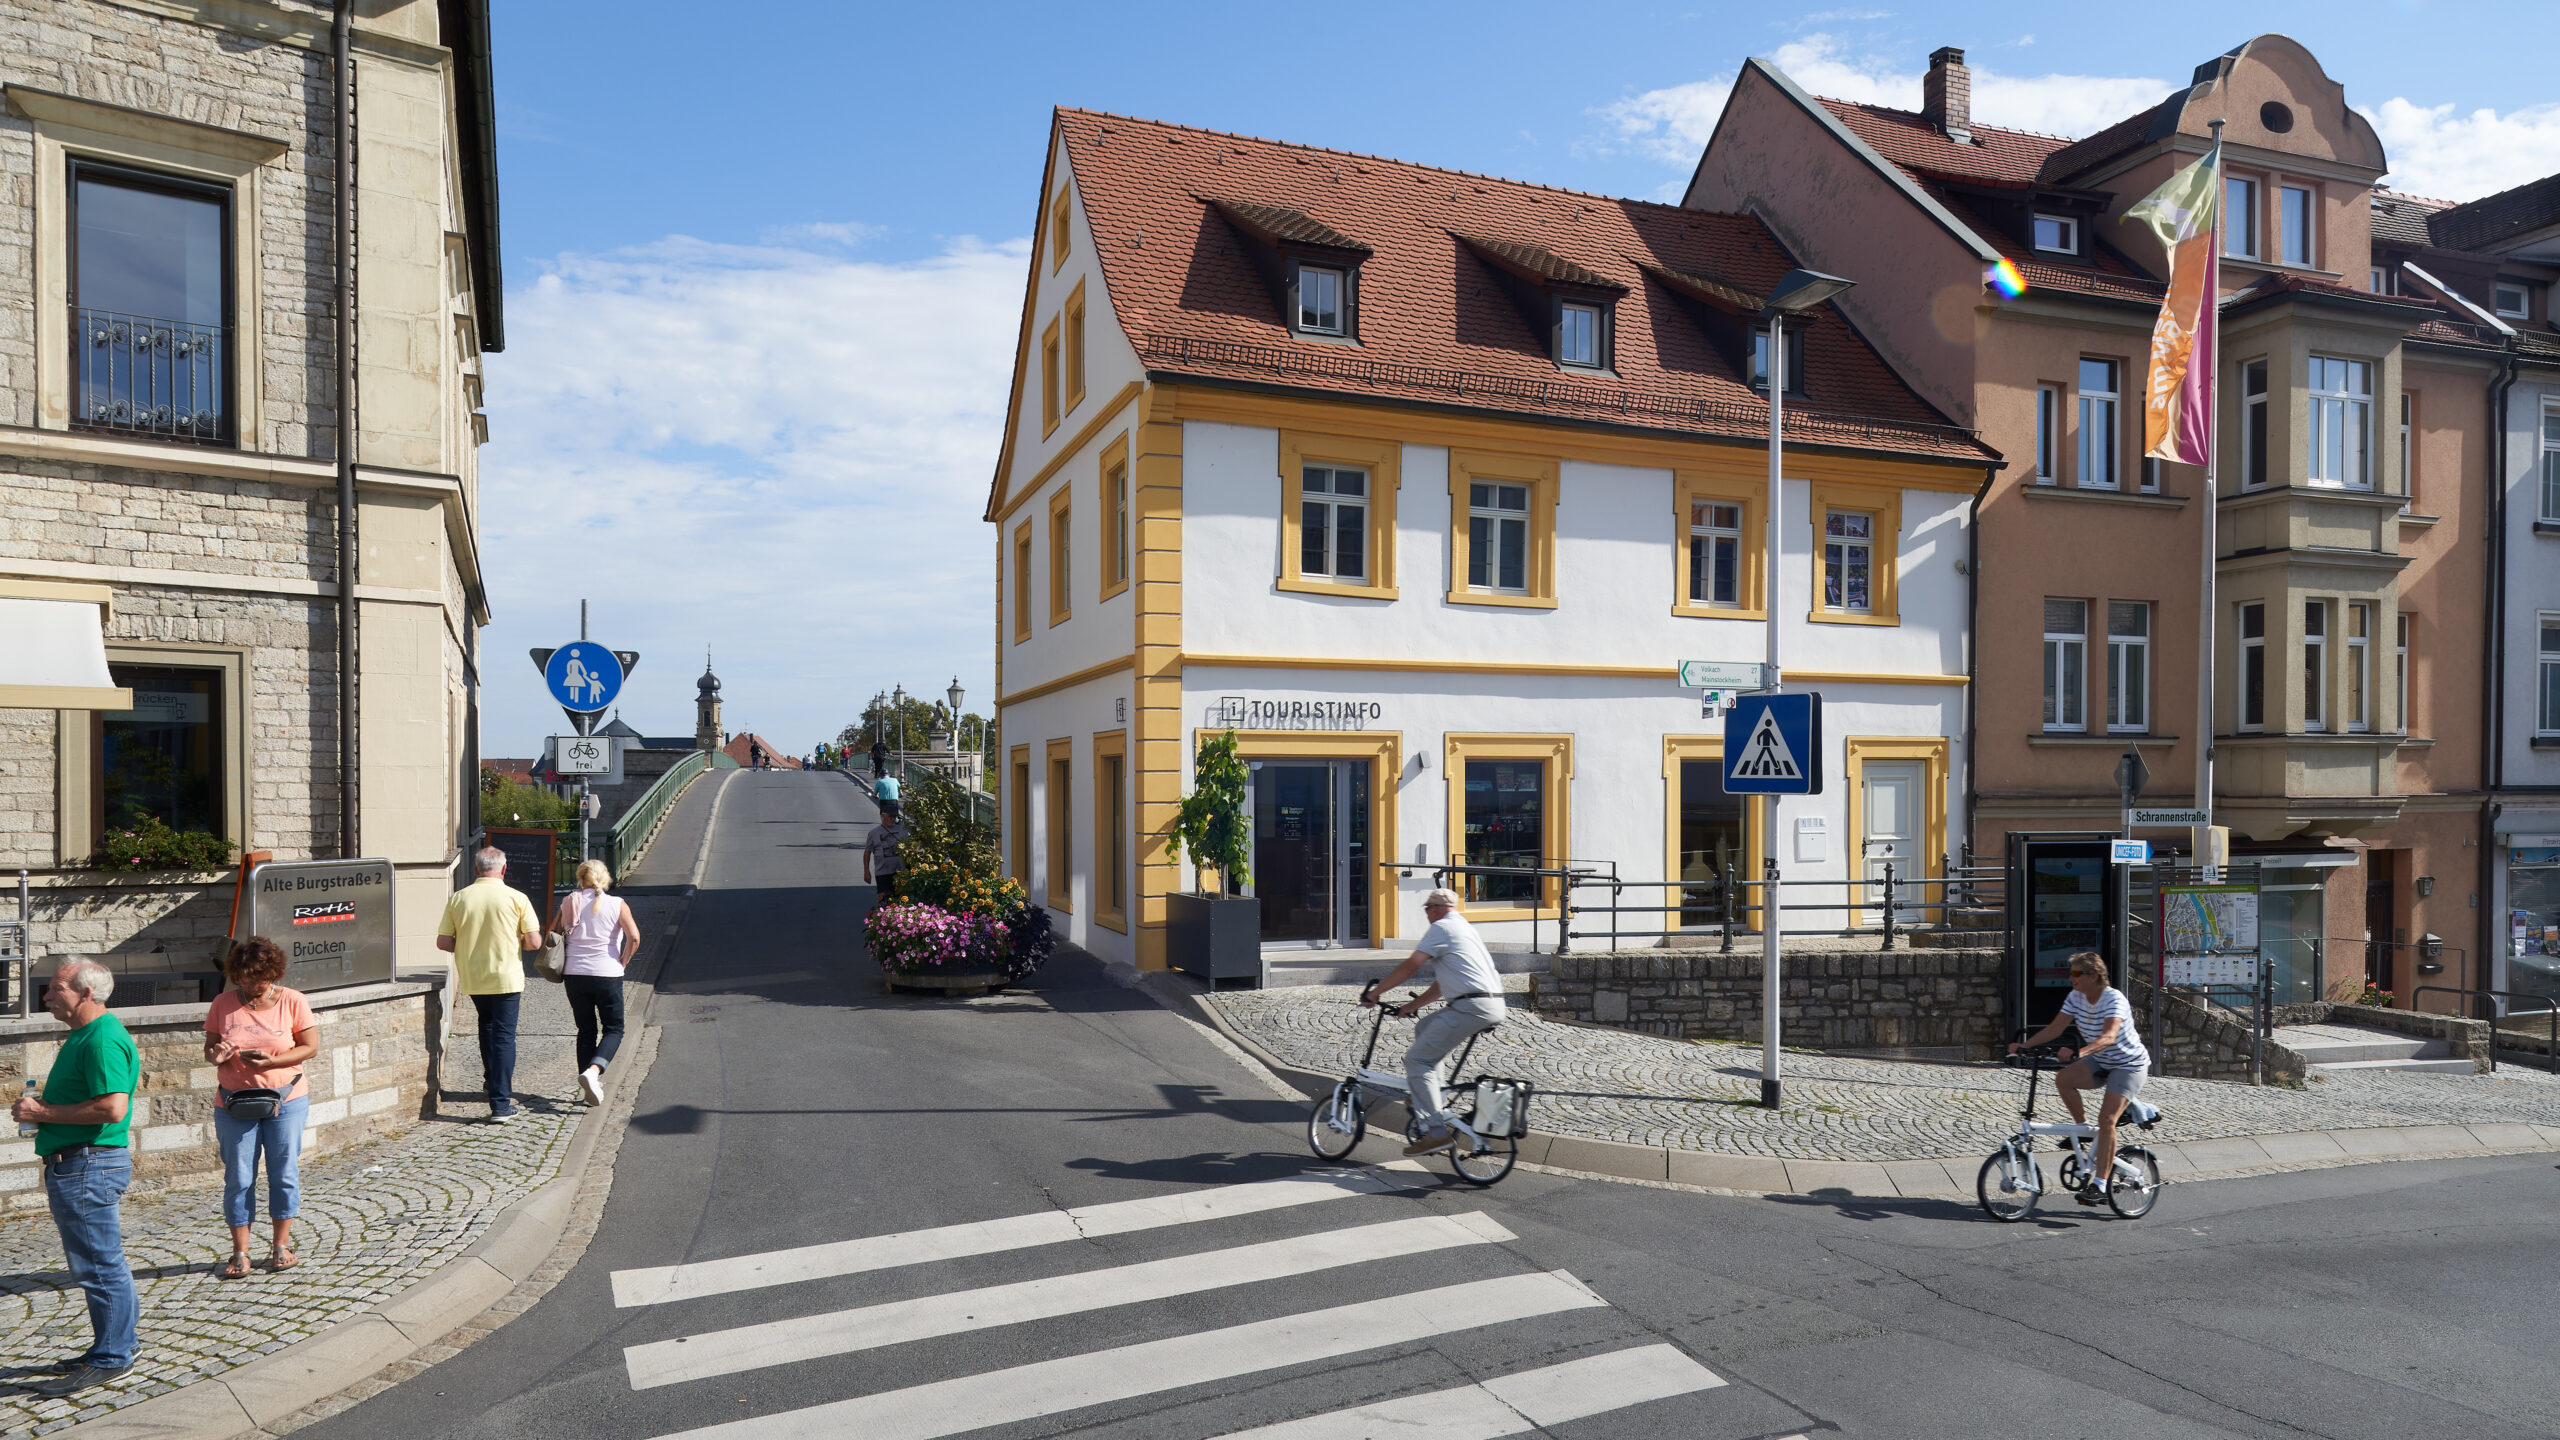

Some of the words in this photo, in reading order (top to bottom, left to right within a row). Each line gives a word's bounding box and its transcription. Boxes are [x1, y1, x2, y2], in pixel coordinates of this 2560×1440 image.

[1751, 667, 1758, 675] 27
[1252, 700, 1381, 720] TOURISTINFO
[575, 760, 594, 770] frei
[2136, 811, 2207, 823] Schrannenstraße
[263, 877, 293, 893] Alte
[296, 873, 372, 892] Burgstraße
[374, 872, 382, 885] 2
[294, 902, 355, 917] Roth
[293, 914, 355, 925] PARTNER
[293, 940, 346, 958] Brücken
